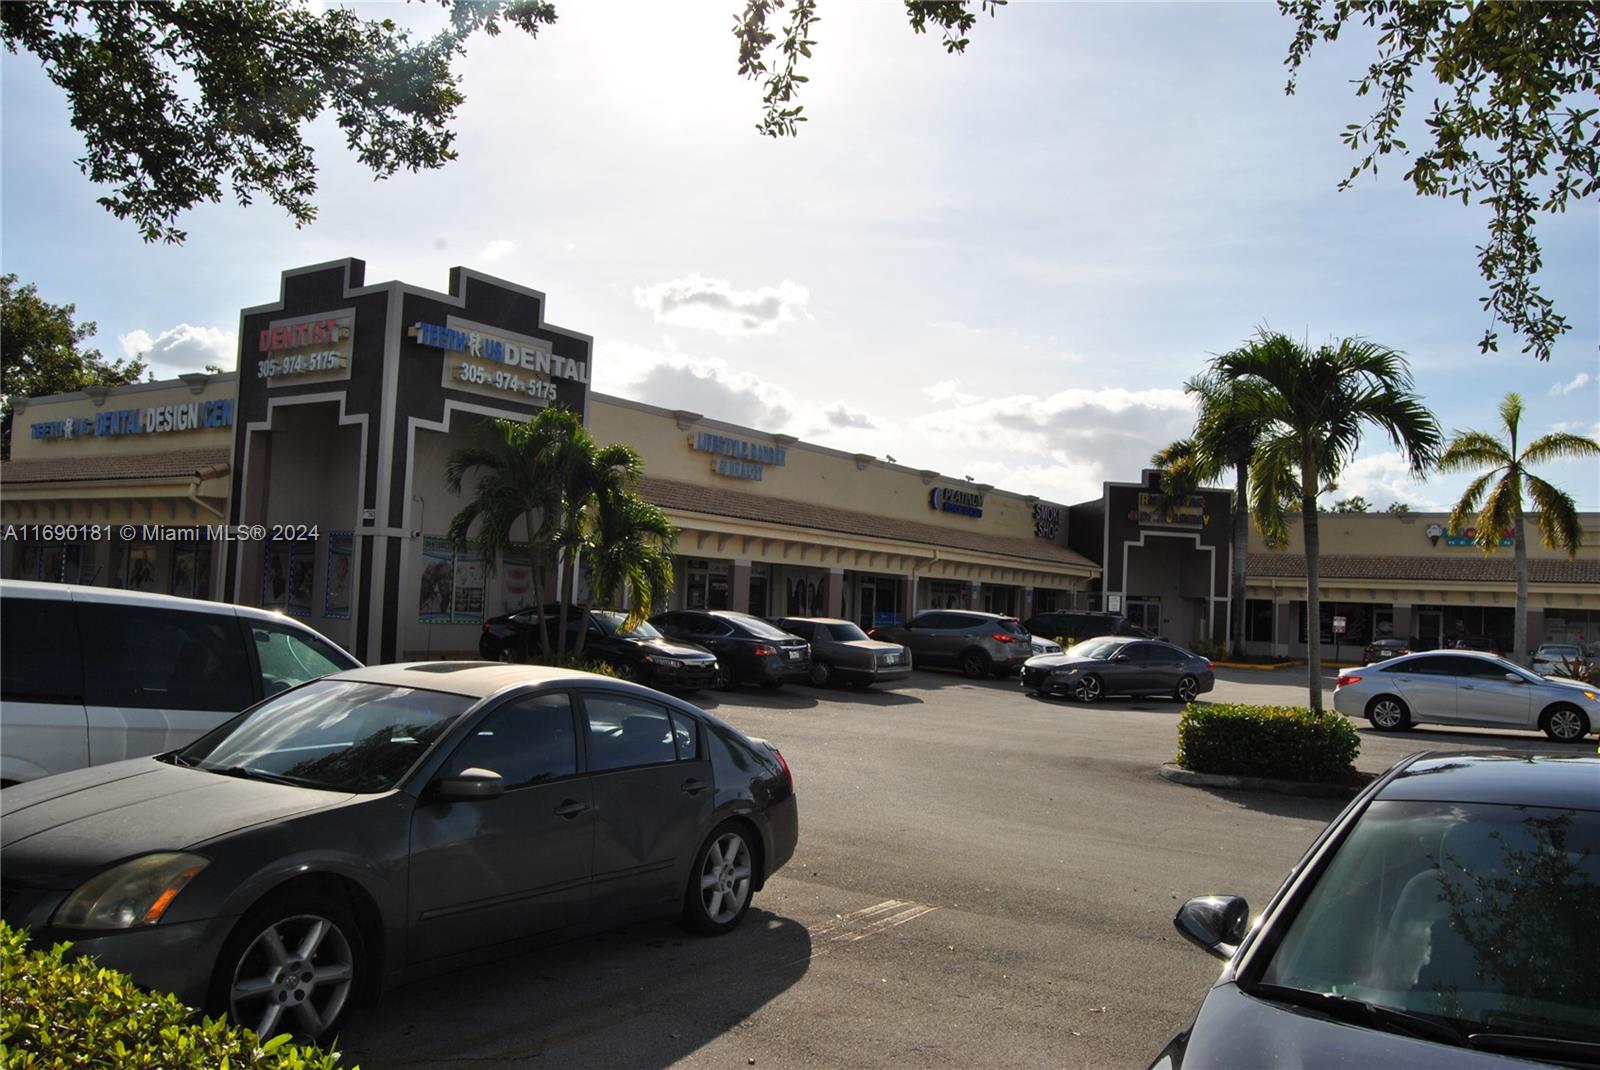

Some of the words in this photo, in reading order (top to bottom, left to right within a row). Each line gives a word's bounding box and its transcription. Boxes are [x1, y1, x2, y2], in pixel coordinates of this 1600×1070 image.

[259, 319, 338, 352] DENTIST
[416, 321, 465, 351] TEETH
[484, 338, 504, 362] US
[504, 343, 588, 384] DENTAL
[95, 408, 143, 437] DENTAL
[146, 403, 199, 433] DESIGN
